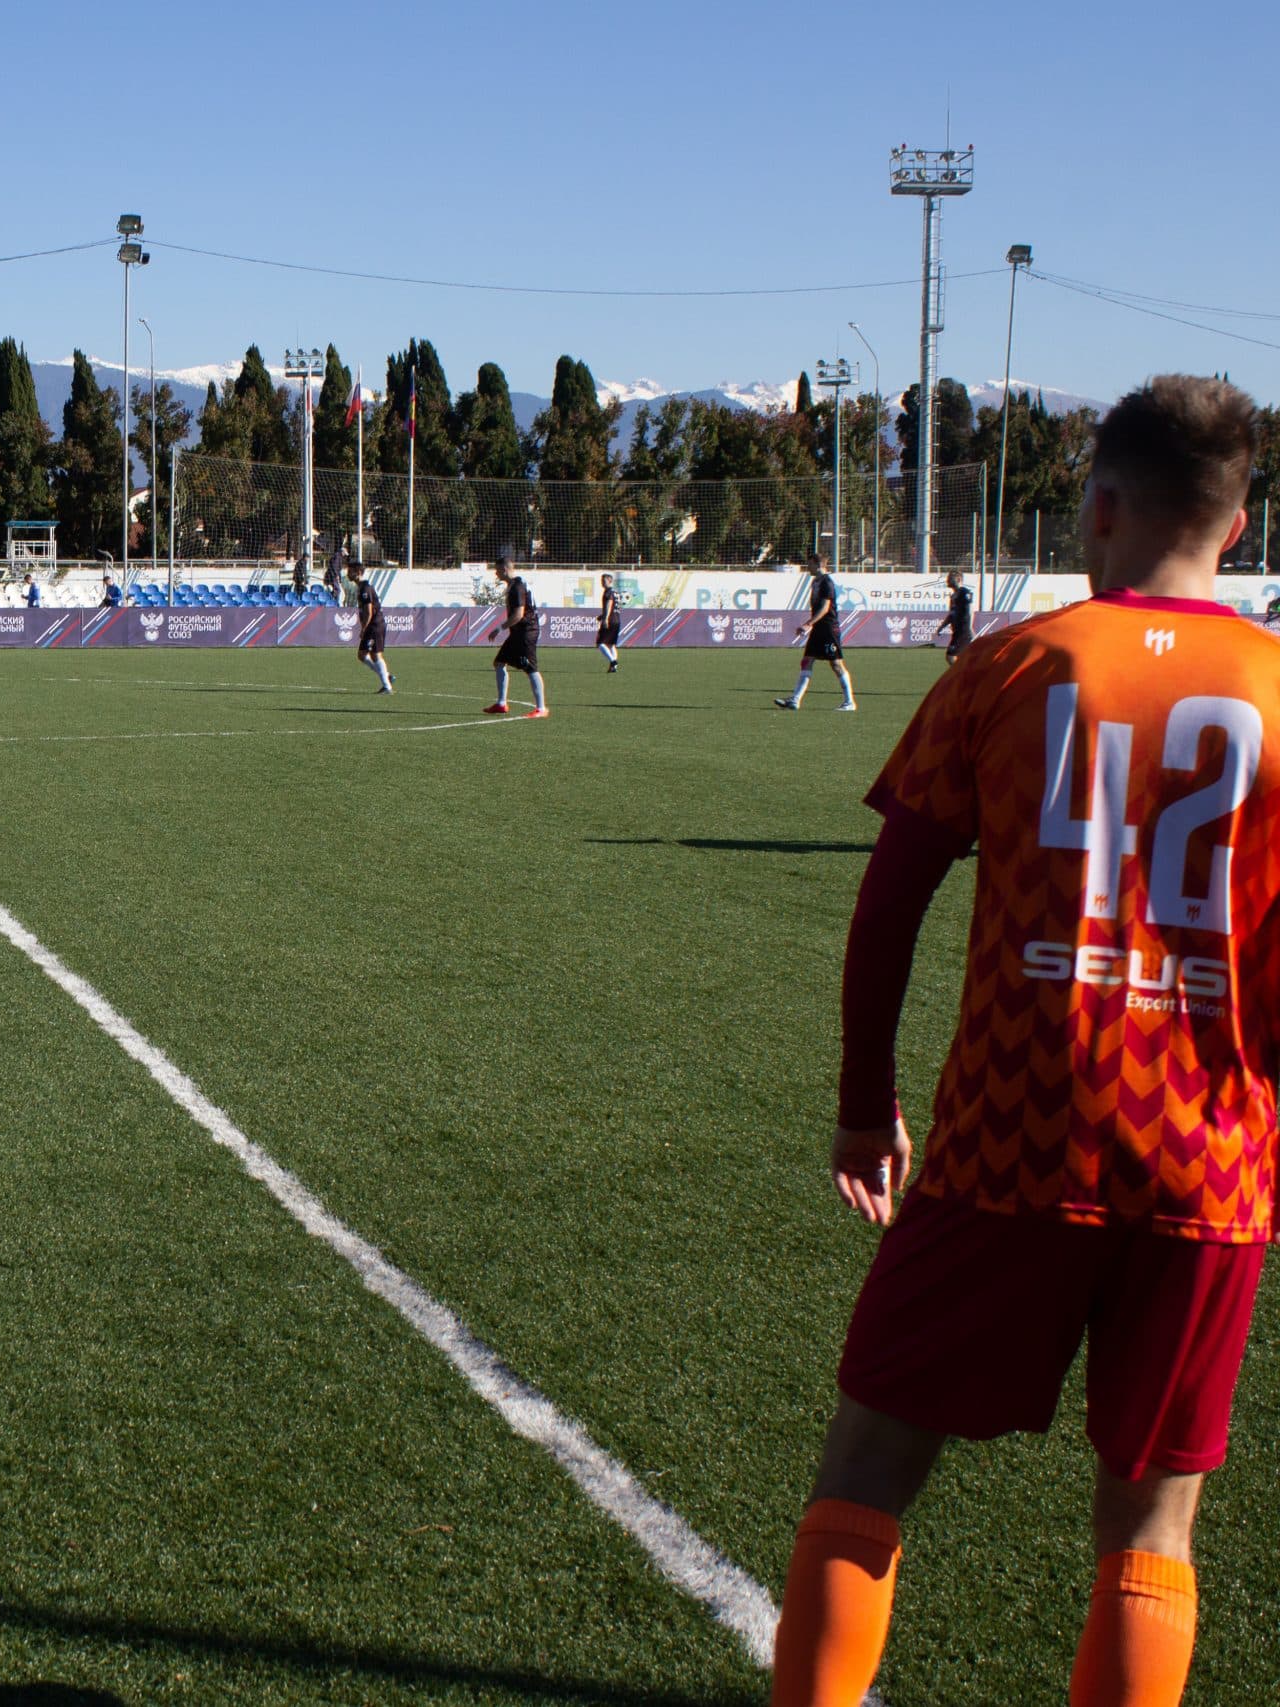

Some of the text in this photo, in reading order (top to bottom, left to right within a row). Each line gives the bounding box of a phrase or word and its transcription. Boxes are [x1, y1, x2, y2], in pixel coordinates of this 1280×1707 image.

[870, 590, 951, 599] ФУТБОЛЬН
[168, 614, 222, 624] РОССИЙСКИЙ
[168, 631, 192, 639] СОЮЗ
[550, 631, 572, 639] СОЮЗ
[1039, 682, 1263, 935] 42
[1022, 940, 1228, 998] SEUS
[1126, 992, 1226, 1019] Export Union
